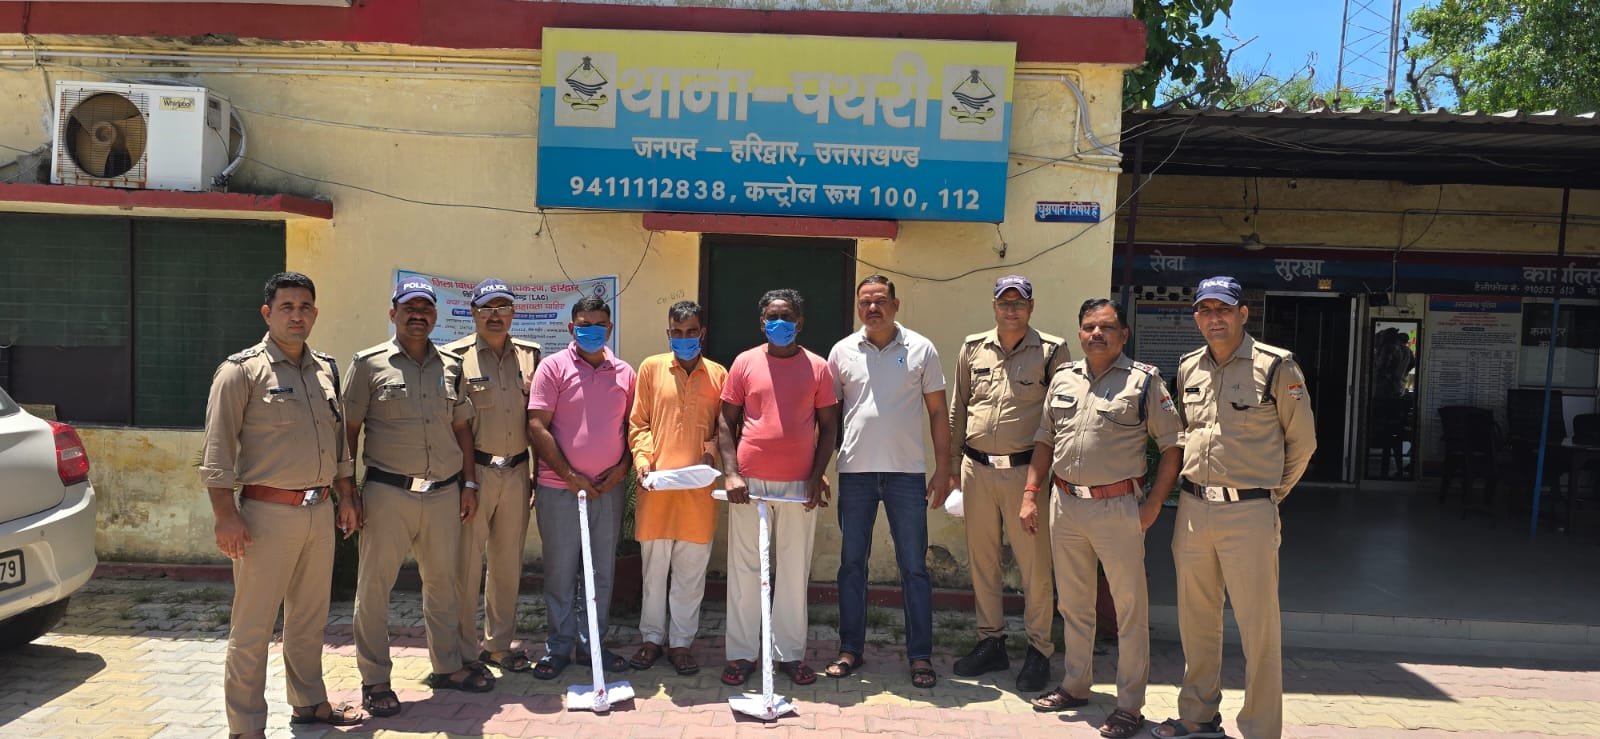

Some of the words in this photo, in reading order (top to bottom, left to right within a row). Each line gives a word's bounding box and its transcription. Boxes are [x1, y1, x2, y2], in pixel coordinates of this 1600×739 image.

[632, 137, 698, 160] जनपद
[729, 133, 806, 166] हरिद्वार,
[813, 142, 920, 168] उत्तराखण्ड
[570, 175, 736, 204] 9411112838,
[744, 176, 817, 207] कन्ट्रोल
[823, 184, 861, 206] रूम
[870, 187, 929, 211] 100,
[939, 189, 980, 211] 112
[1149, 250, 1186, 272] सेवा
[1274, 258, 1325, 281] सुरक्षा
